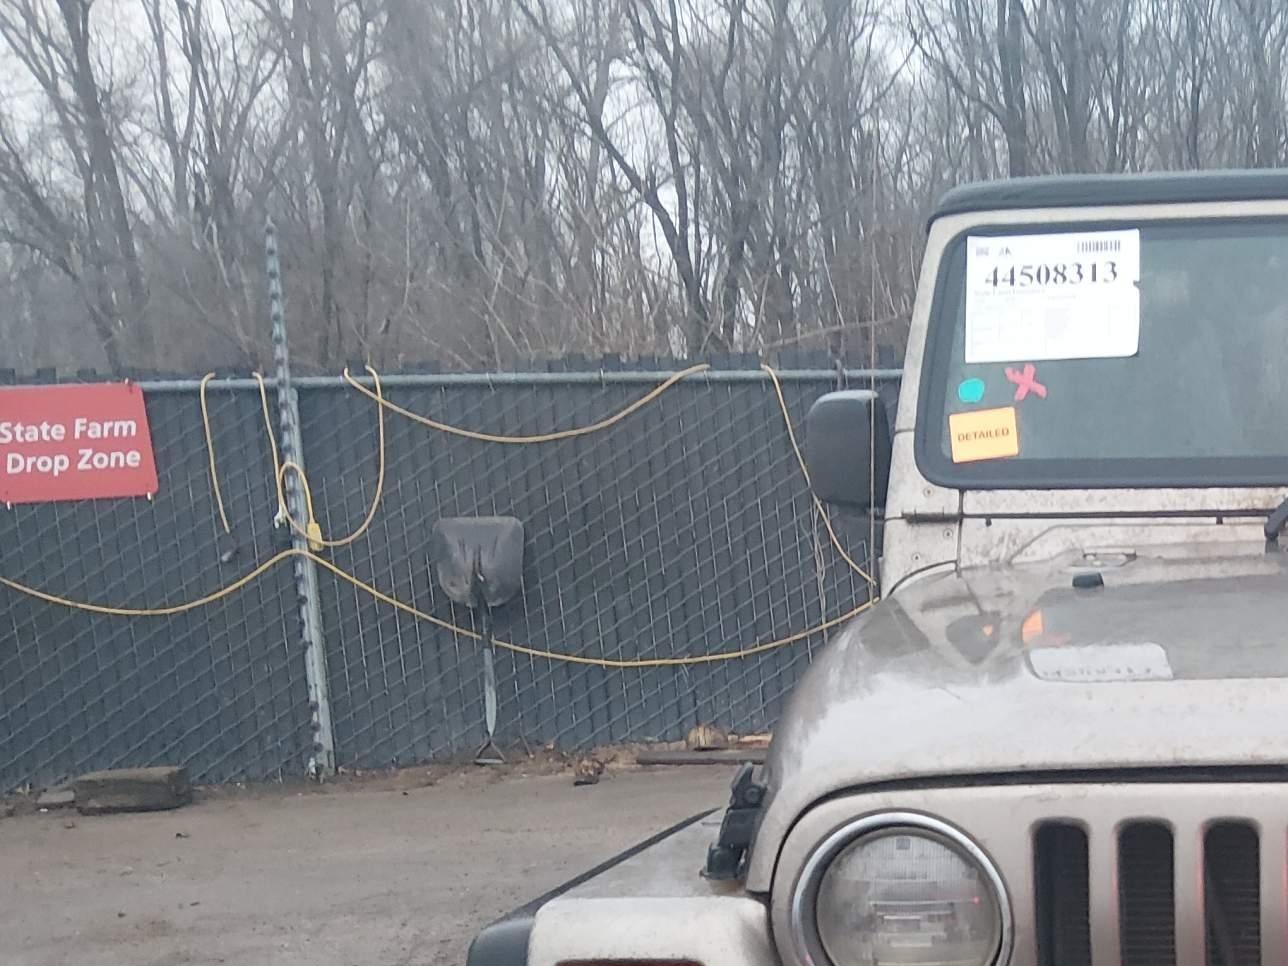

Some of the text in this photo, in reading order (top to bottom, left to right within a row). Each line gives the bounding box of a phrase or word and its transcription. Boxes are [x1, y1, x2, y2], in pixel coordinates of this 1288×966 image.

[985, 261, 1118, 287] 44508313
[0, 417, 137, 443] State Farm
[957, 427, 1010, 443] DETAILED
[6, 448, 141, 477] Drop Zone
